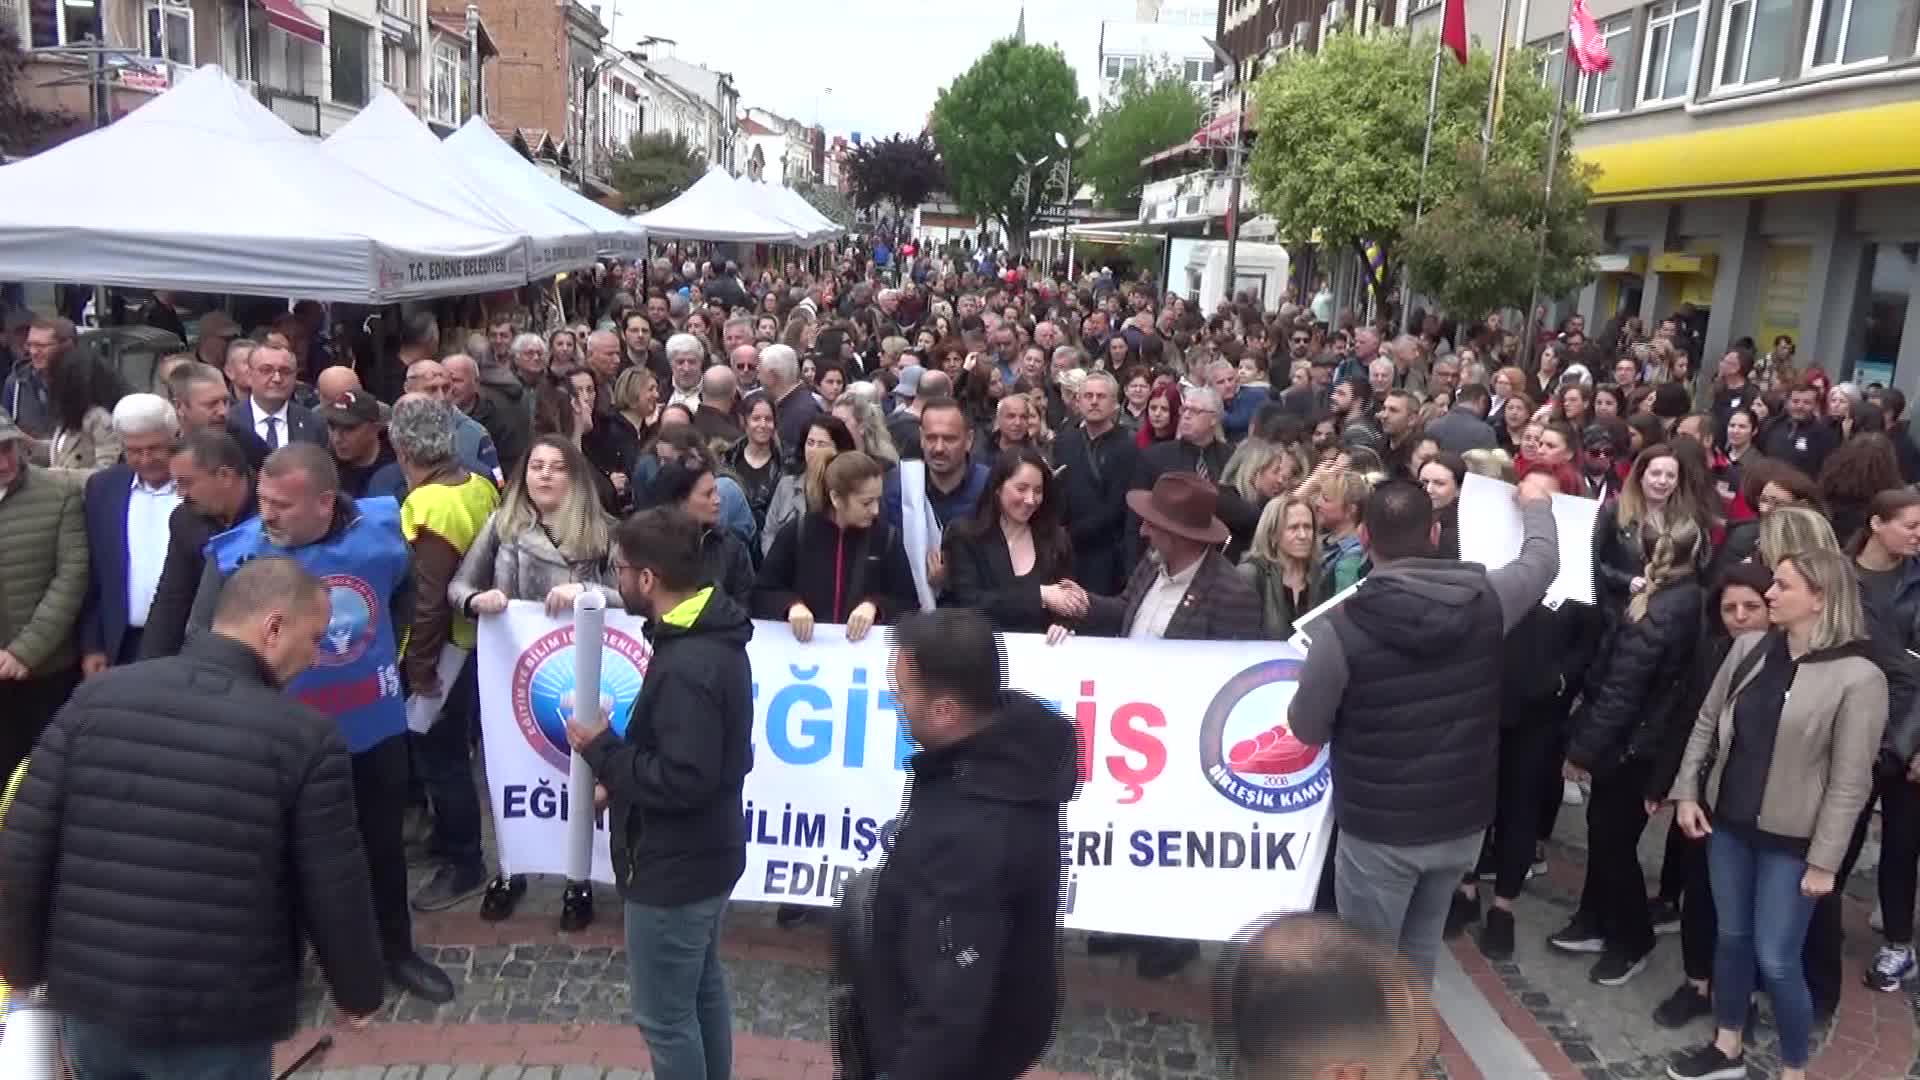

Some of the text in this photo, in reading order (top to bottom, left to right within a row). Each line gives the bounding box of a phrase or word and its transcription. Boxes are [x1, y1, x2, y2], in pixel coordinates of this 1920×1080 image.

[429, 257, 462, 280] EDİRNE
[1076, 680, 1167, 804] İŞ
[1208, 764, 1274, 808] BİRLEŞİK
[1264, 775, 1289, 786] 2008
